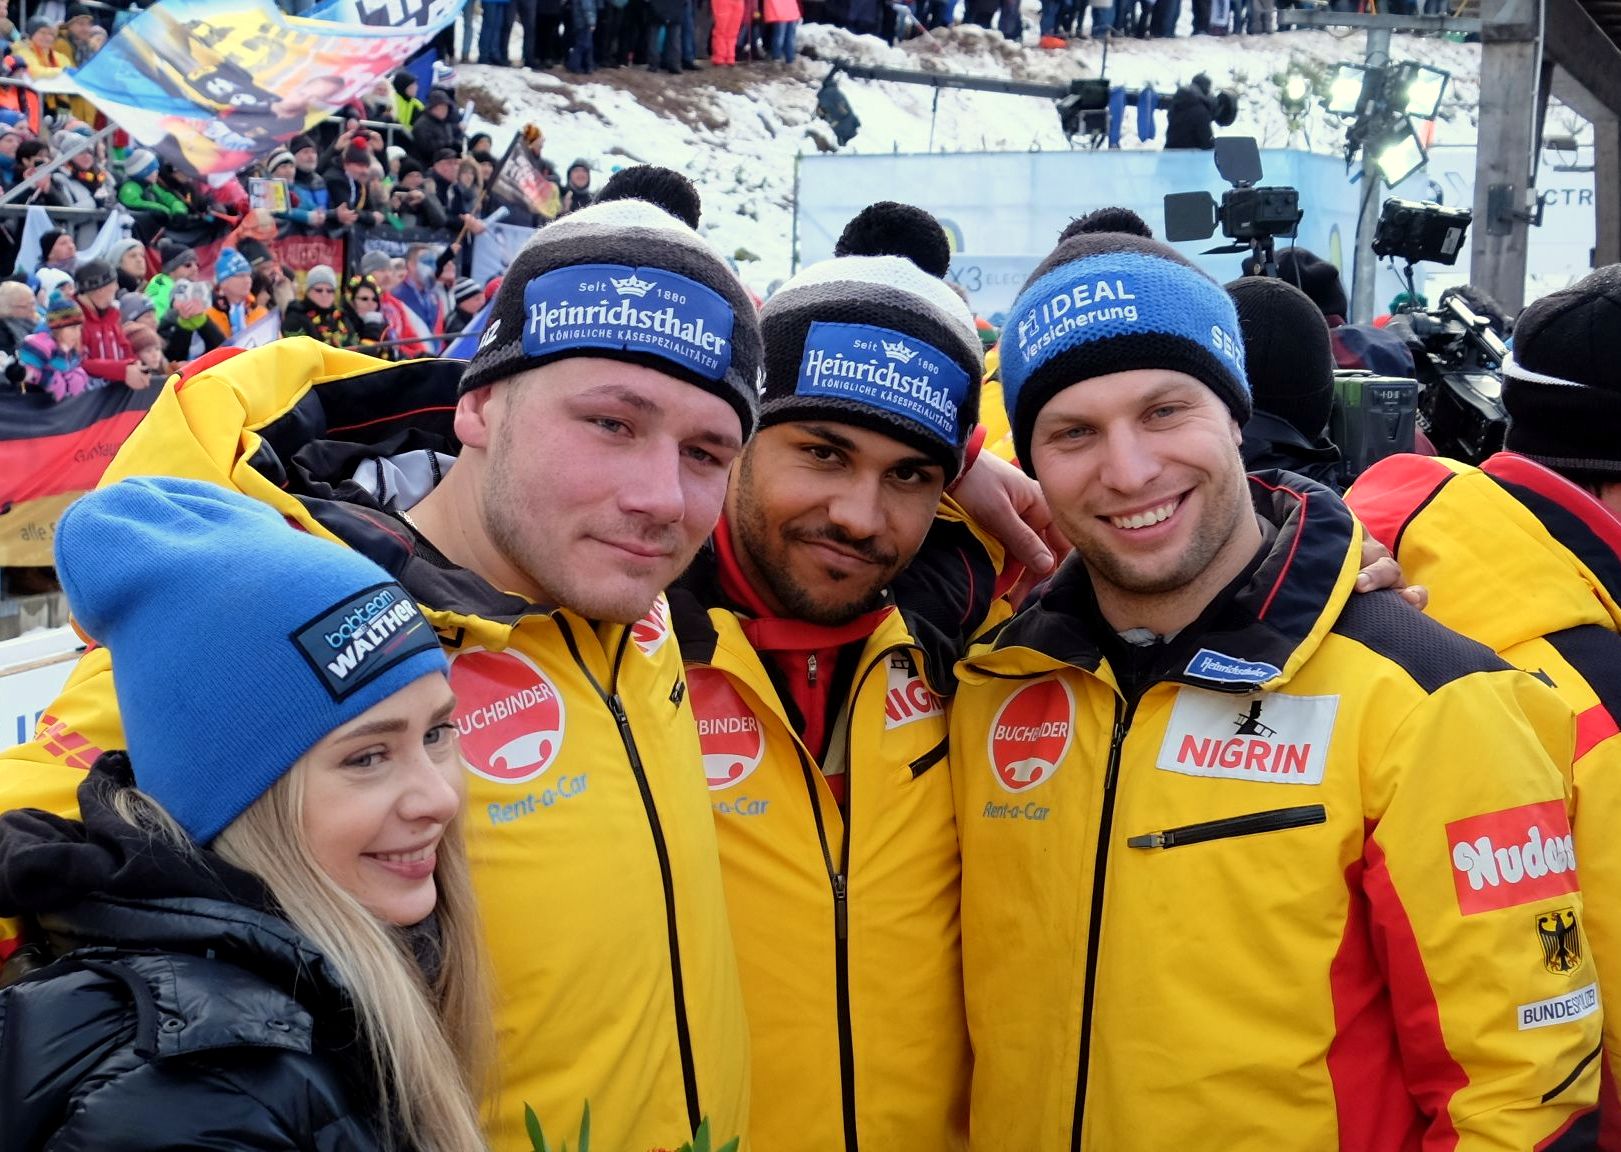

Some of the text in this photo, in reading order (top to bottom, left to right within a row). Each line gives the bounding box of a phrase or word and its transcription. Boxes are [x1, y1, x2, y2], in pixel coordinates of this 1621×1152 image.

[578, 281, 687, 305] Seit 1880
[1042, 280, 1136, 323] IDEAL
[529, 299, 726, 356] Heinrichsthaler
[1022, 304, 1138, 363] Versicherung
[549, 329, 719, 370] KÖNIGLICHE KÄSESPEZIALITÄTEN
[853, 339, 940, 375] Seit 1880
[806, 349, 958, 421] Heinrichsthaler
[821, 379, 877, 397] KÖNIGLICHE
[324, 590, 396, 648] bobteam
[697, 716, 757, 736] BINDER
[1176, 734, 1312, 774] NIGRIN
[487, 771, 588, 825] Rent-a-Car
[983, 801, 1050, 820] Rent-a-Car
